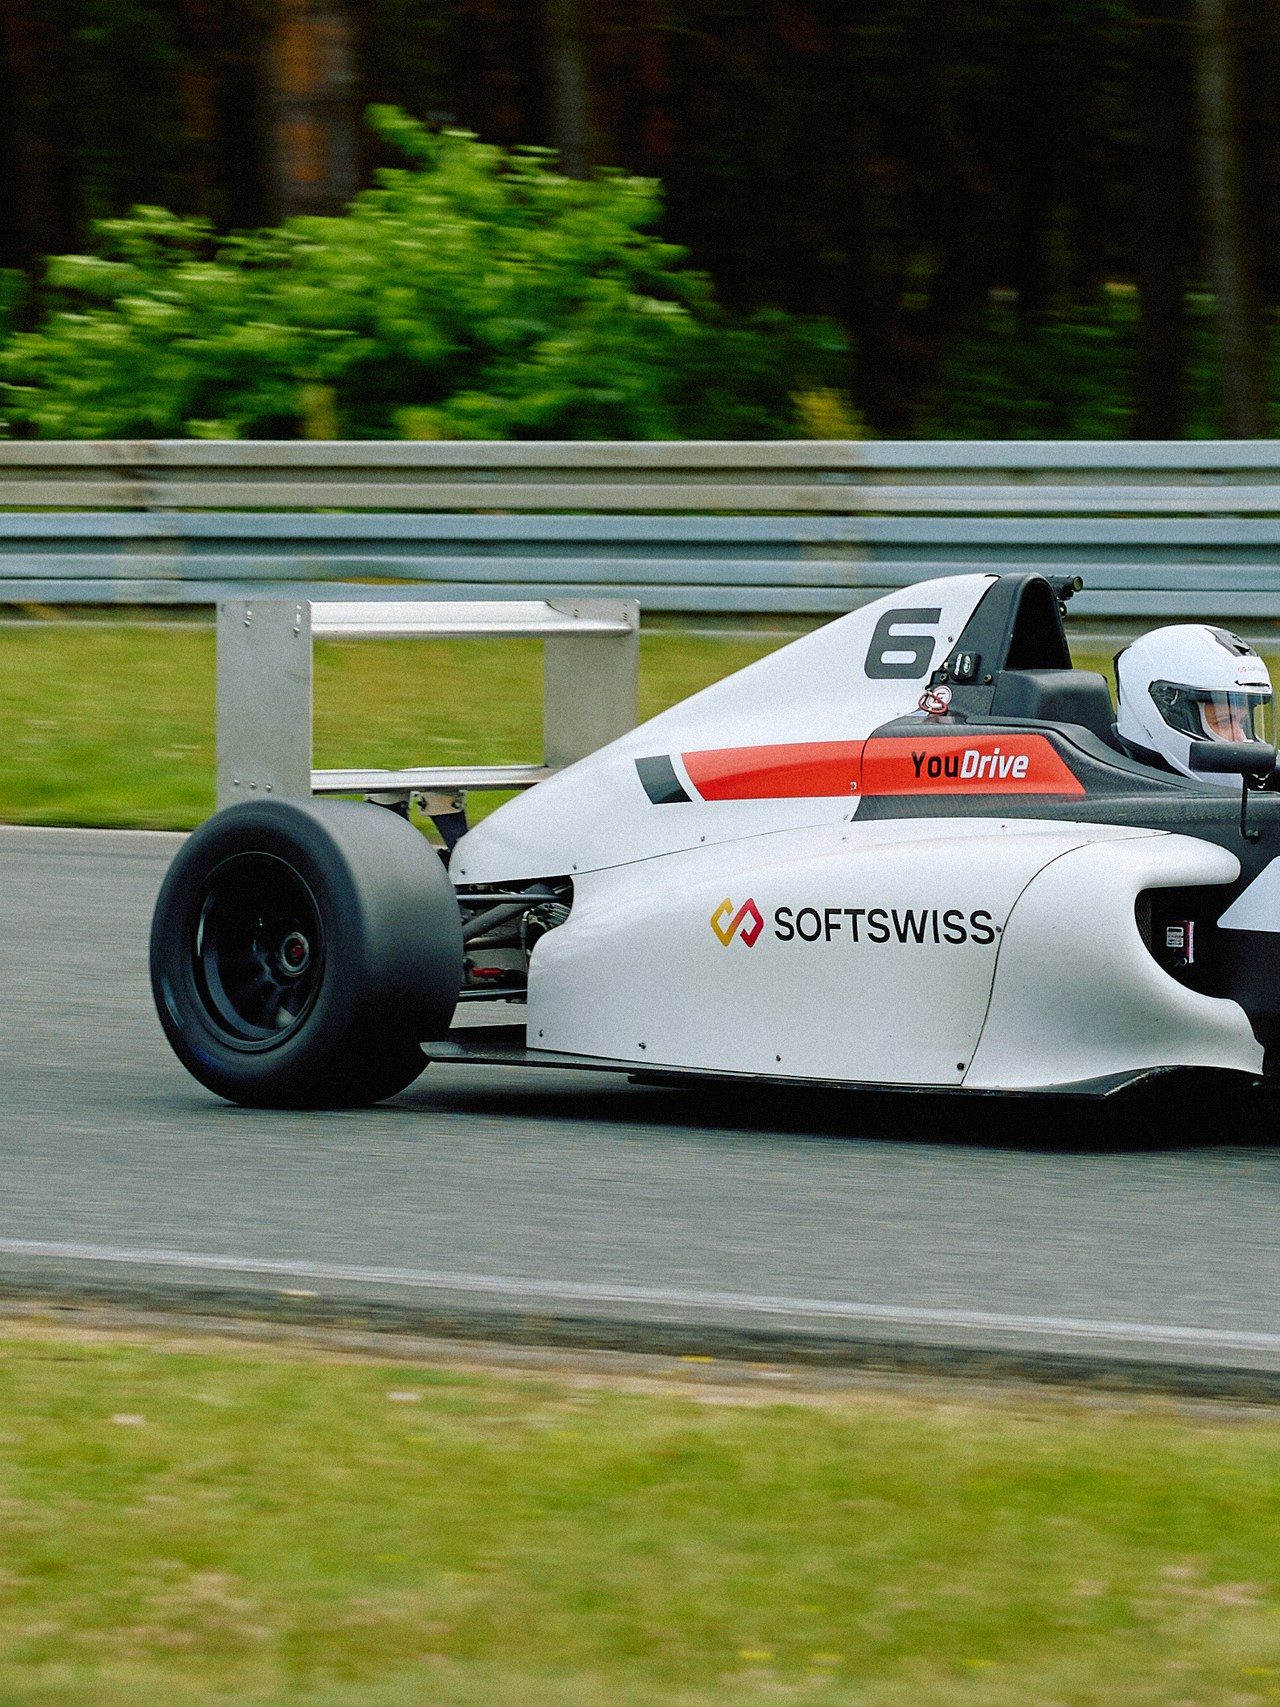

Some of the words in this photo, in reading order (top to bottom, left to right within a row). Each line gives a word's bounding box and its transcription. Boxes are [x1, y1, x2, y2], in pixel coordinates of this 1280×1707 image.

[864, 608, 942, 679] 6
[911, 747, 1030, 779] YouDrive
[774, 906, 996, 945] SOFTSWISS
